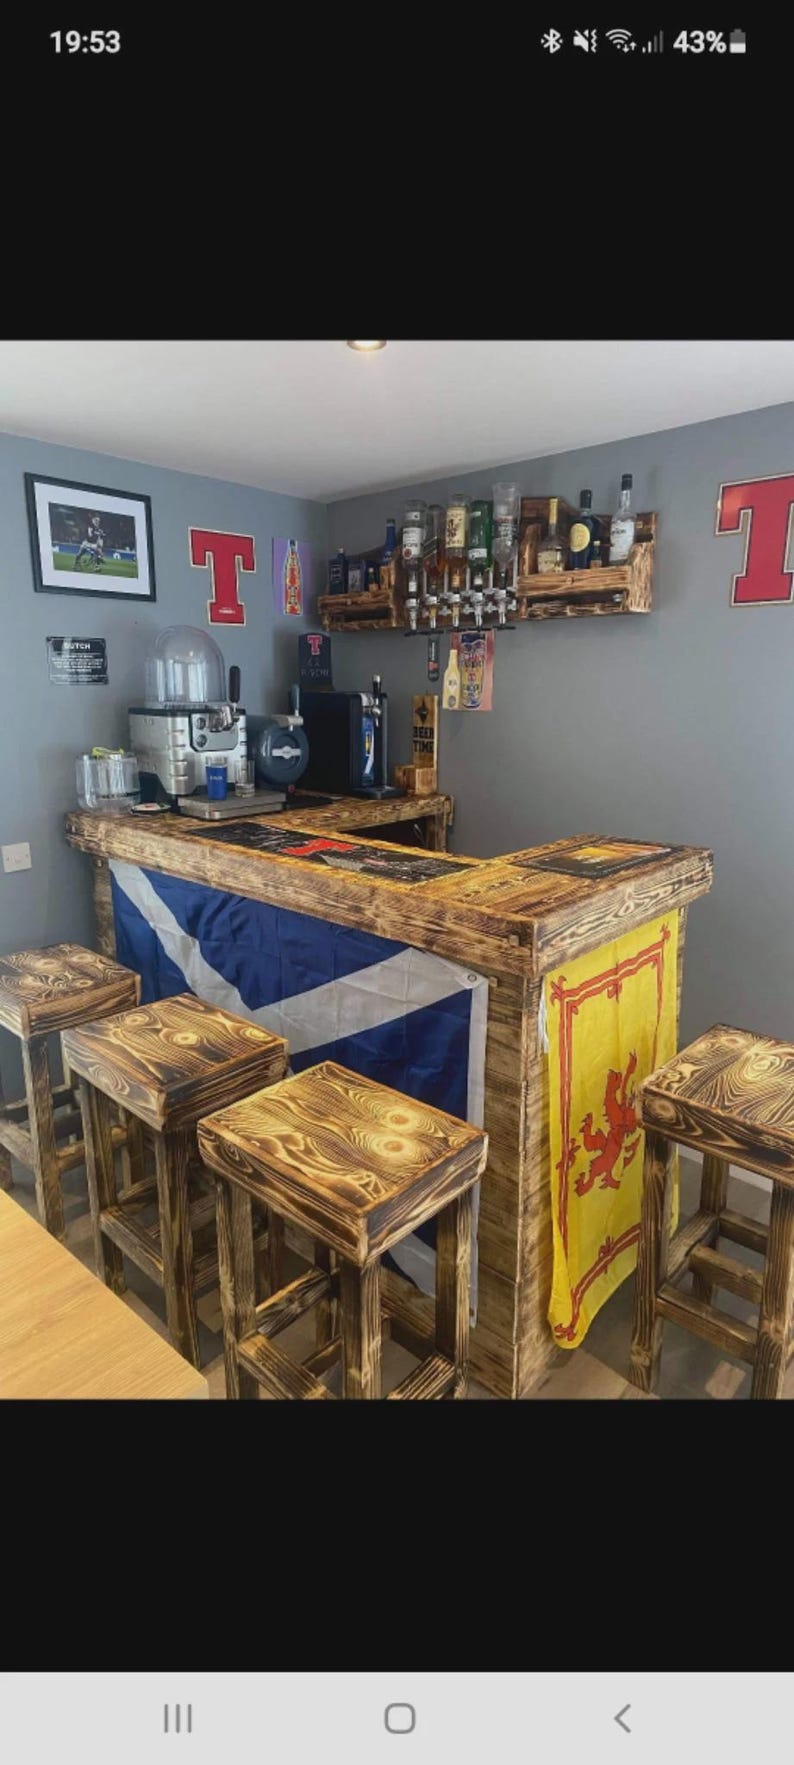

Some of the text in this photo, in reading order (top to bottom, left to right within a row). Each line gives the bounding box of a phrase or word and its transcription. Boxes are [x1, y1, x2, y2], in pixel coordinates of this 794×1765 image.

[716, 472, 794, 606] T
[188, 526, 256, 627] T
[307, 634, 323, 656] T
[413, 726, 434, 739] BEER
[413, 740, 434, 753] TIME
